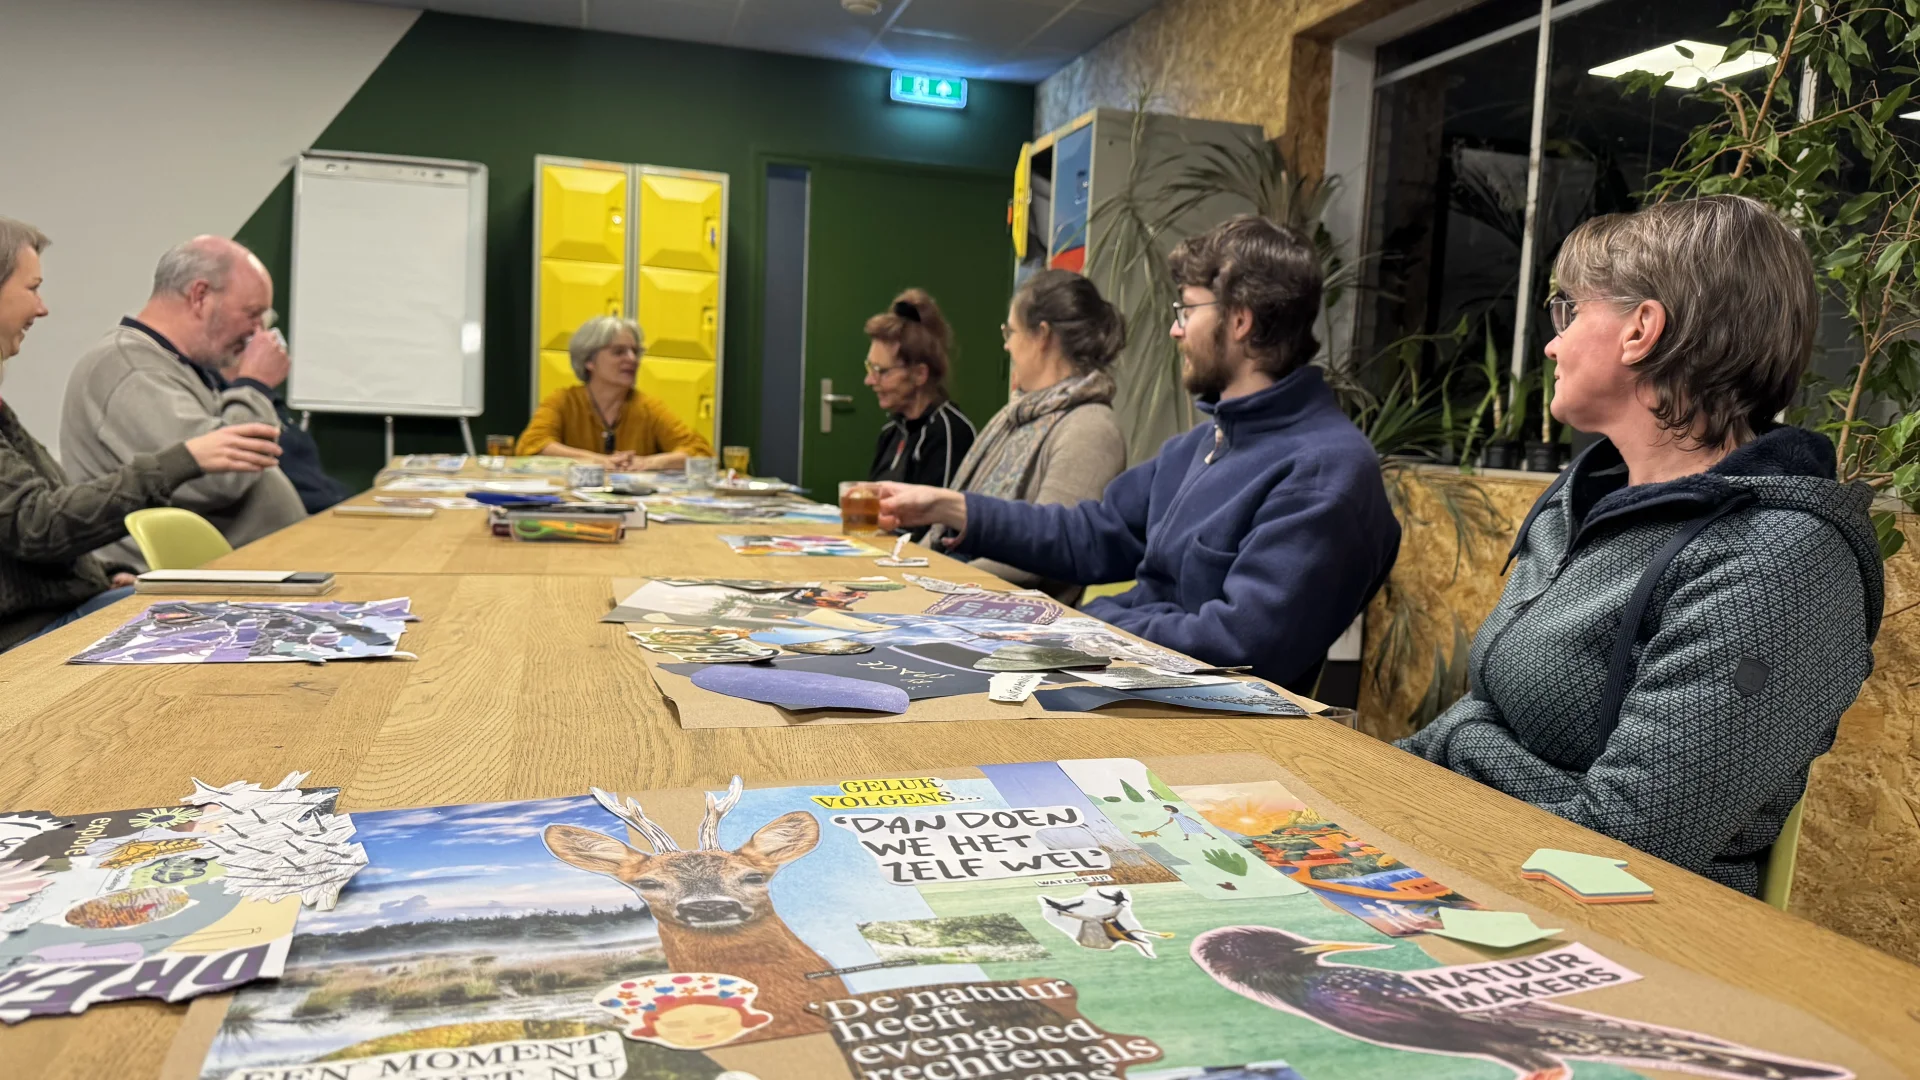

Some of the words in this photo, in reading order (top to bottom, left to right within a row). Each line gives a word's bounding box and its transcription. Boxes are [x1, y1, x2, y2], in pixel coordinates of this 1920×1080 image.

[857, 660, 955, 679] SPACE
[814, 790, 983, 808] VOLGENS...
[842, 777, 944, 794] GELUK
[955, 807, 1079, 829] DOEN
[64, 817, 112, 856] explore
[862, 838, 935, 858] WE
[951, 833, 1032, 854] HET
[881, 858, 986, 883] ZELF
[1413, 952, 1592, 991] NATUUR
[907, 978, 1072, 1011] natuur
[1442, 967, 1623, 1011] MAKERS
[833, 1006, 976, 1043] heeft
[381, 1035, 607, 1077] MOMENT
[851, 1018, 1104, 1065] evengoed
[550, 1057, 621, 1080] NU
[864, 1048, 1081, 1080] rechten
[1081, 1037, 1159, 1065] als
